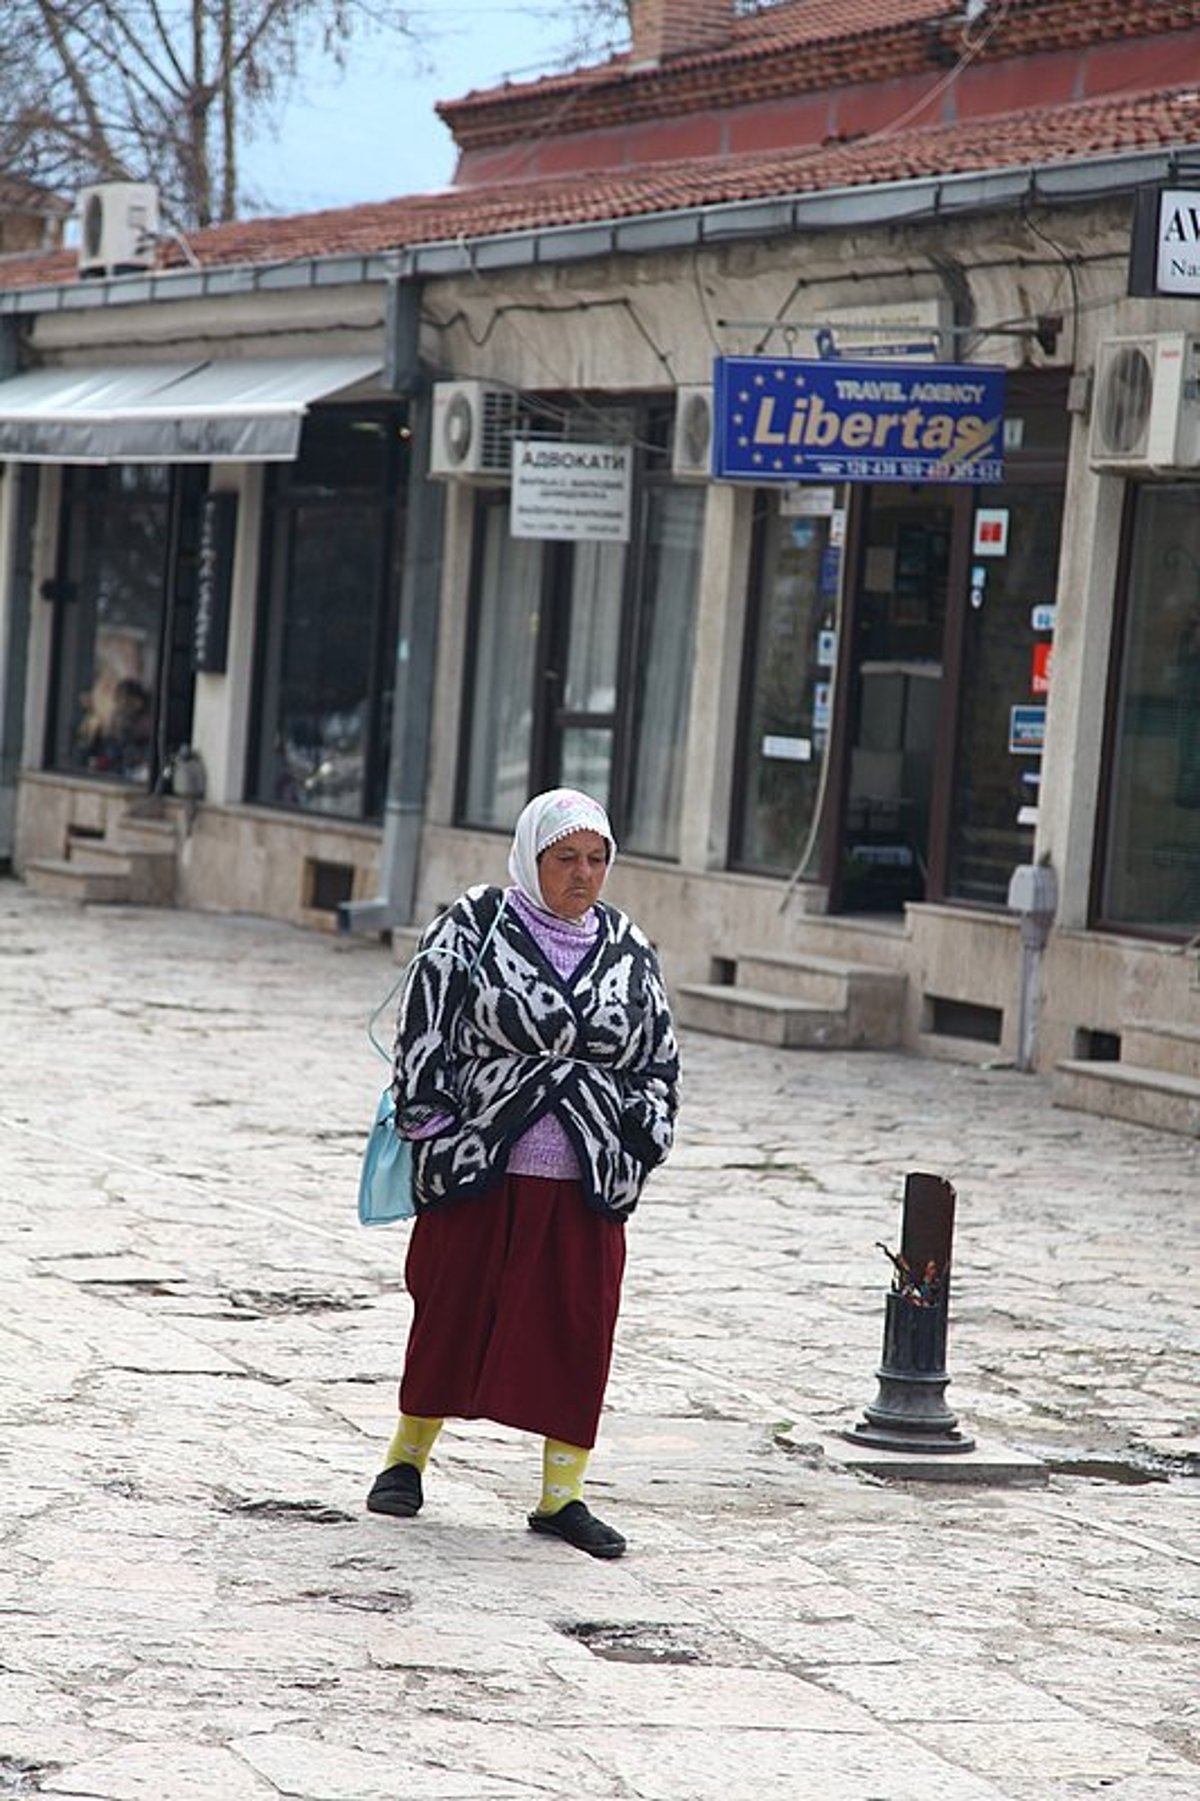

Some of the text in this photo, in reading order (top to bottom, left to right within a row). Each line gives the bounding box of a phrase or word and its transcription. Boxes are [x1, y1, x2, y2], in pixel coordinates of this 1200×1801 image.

[1170, 259, 1200, 277] Na
[835, 380, 985, 404] TRAVEL AGENCY
[753, 395, 986, 450] Libertas
[522, 450, 626, 470] АДВОКАТИ
